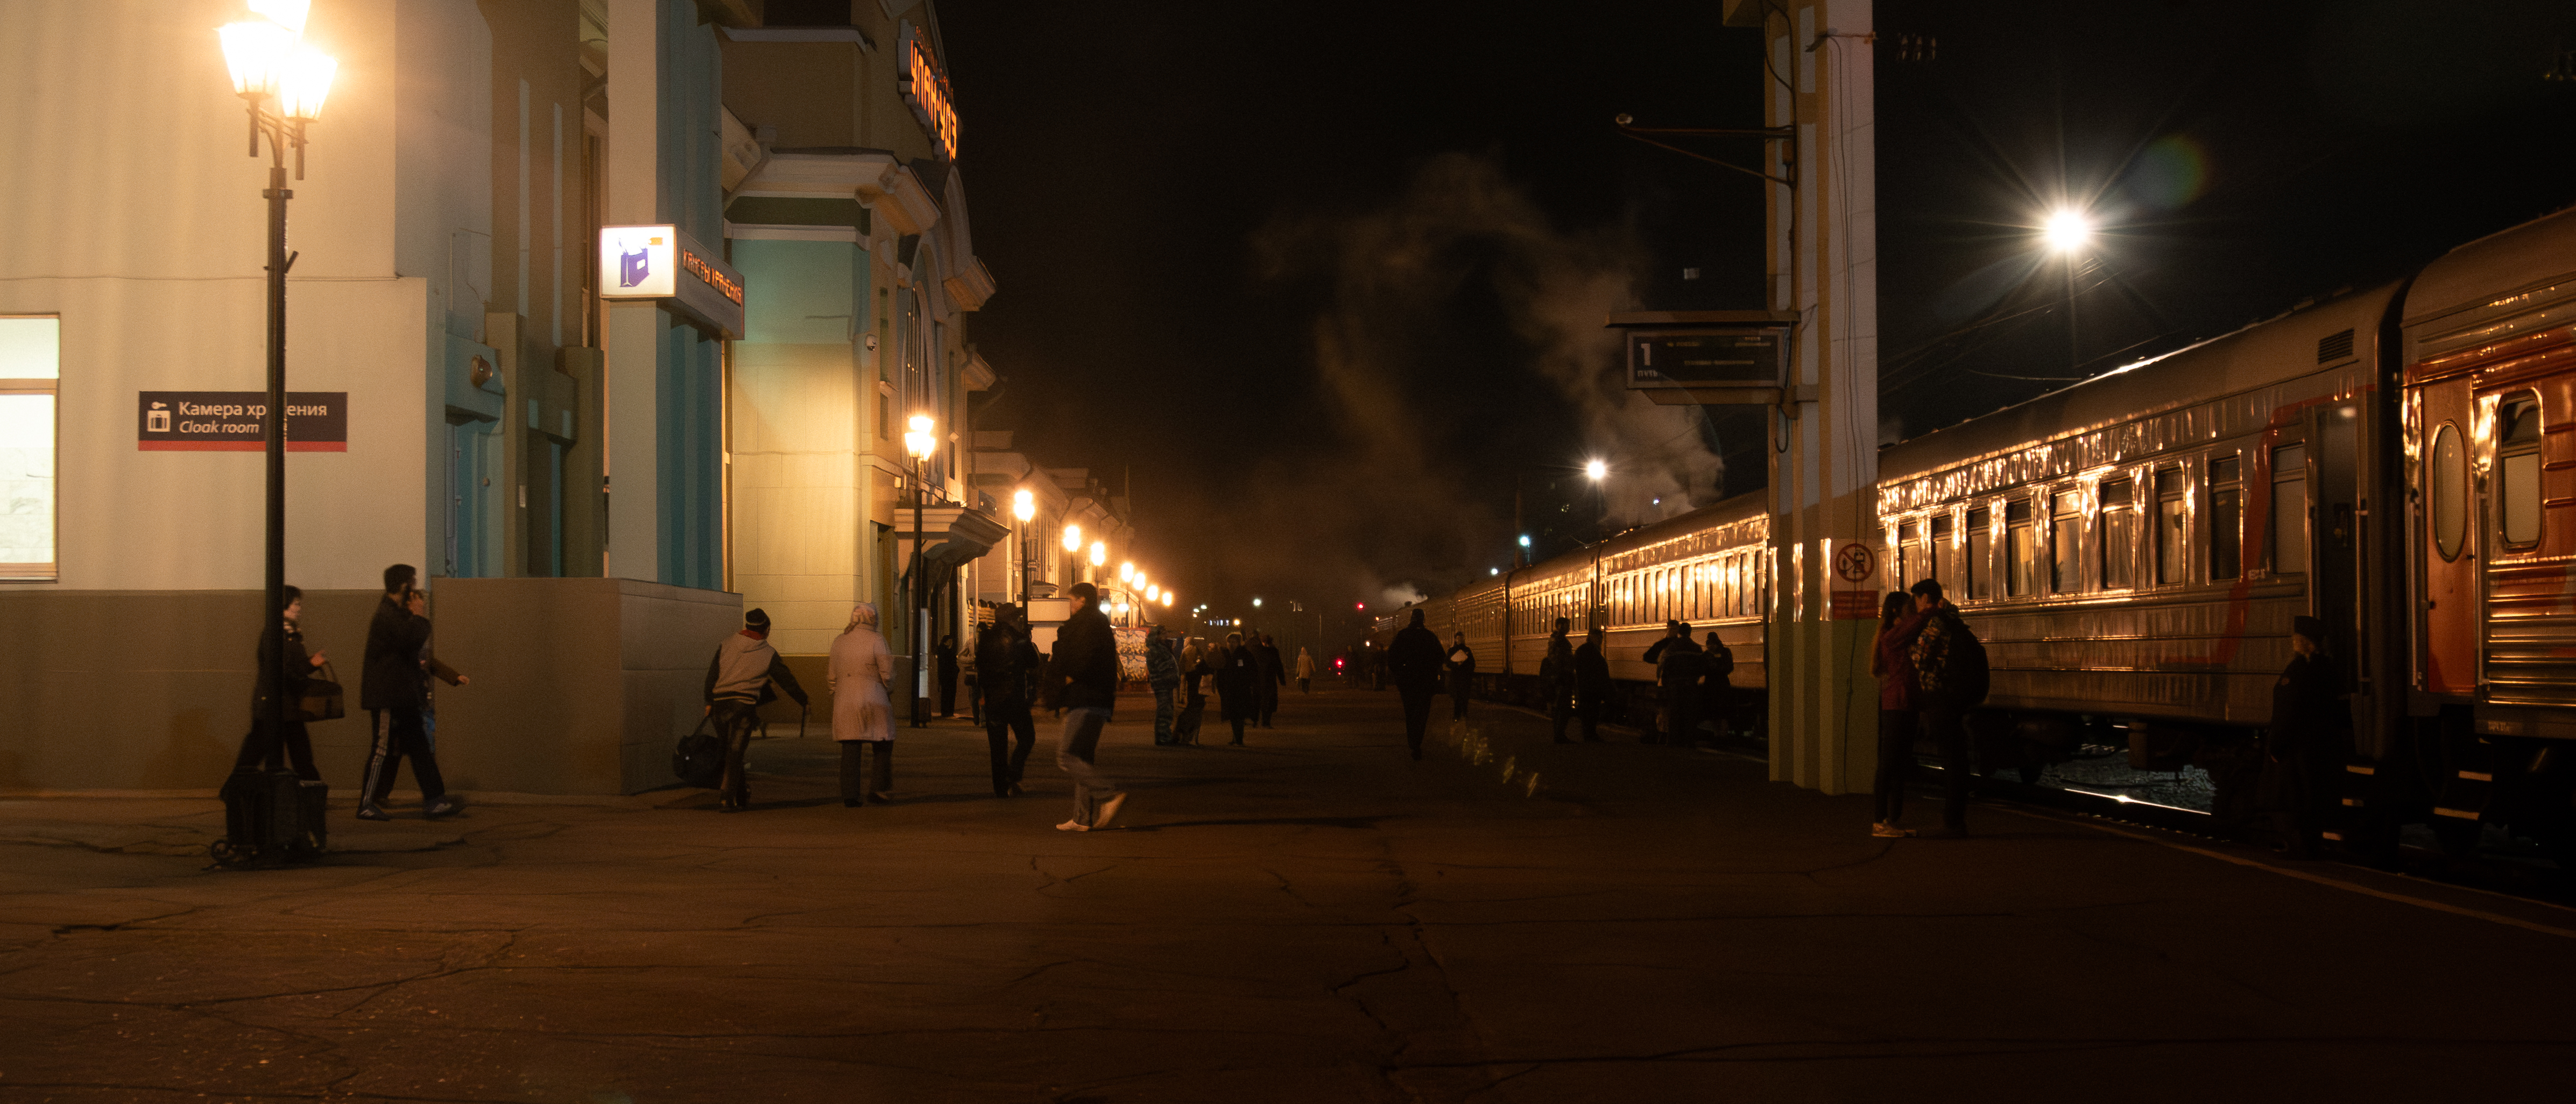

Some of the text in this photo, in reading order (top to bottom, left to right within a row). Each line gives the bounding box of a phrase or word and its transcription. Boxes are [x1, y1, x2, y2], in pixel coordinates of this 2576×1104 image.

[911, 39, 957, 163] УЛАН-УДЭ
[1641, 343, 1651, 366] 1
[179, 402, 327, 420] Камера хрения
[179, 420, 259, 433] Cloak room
